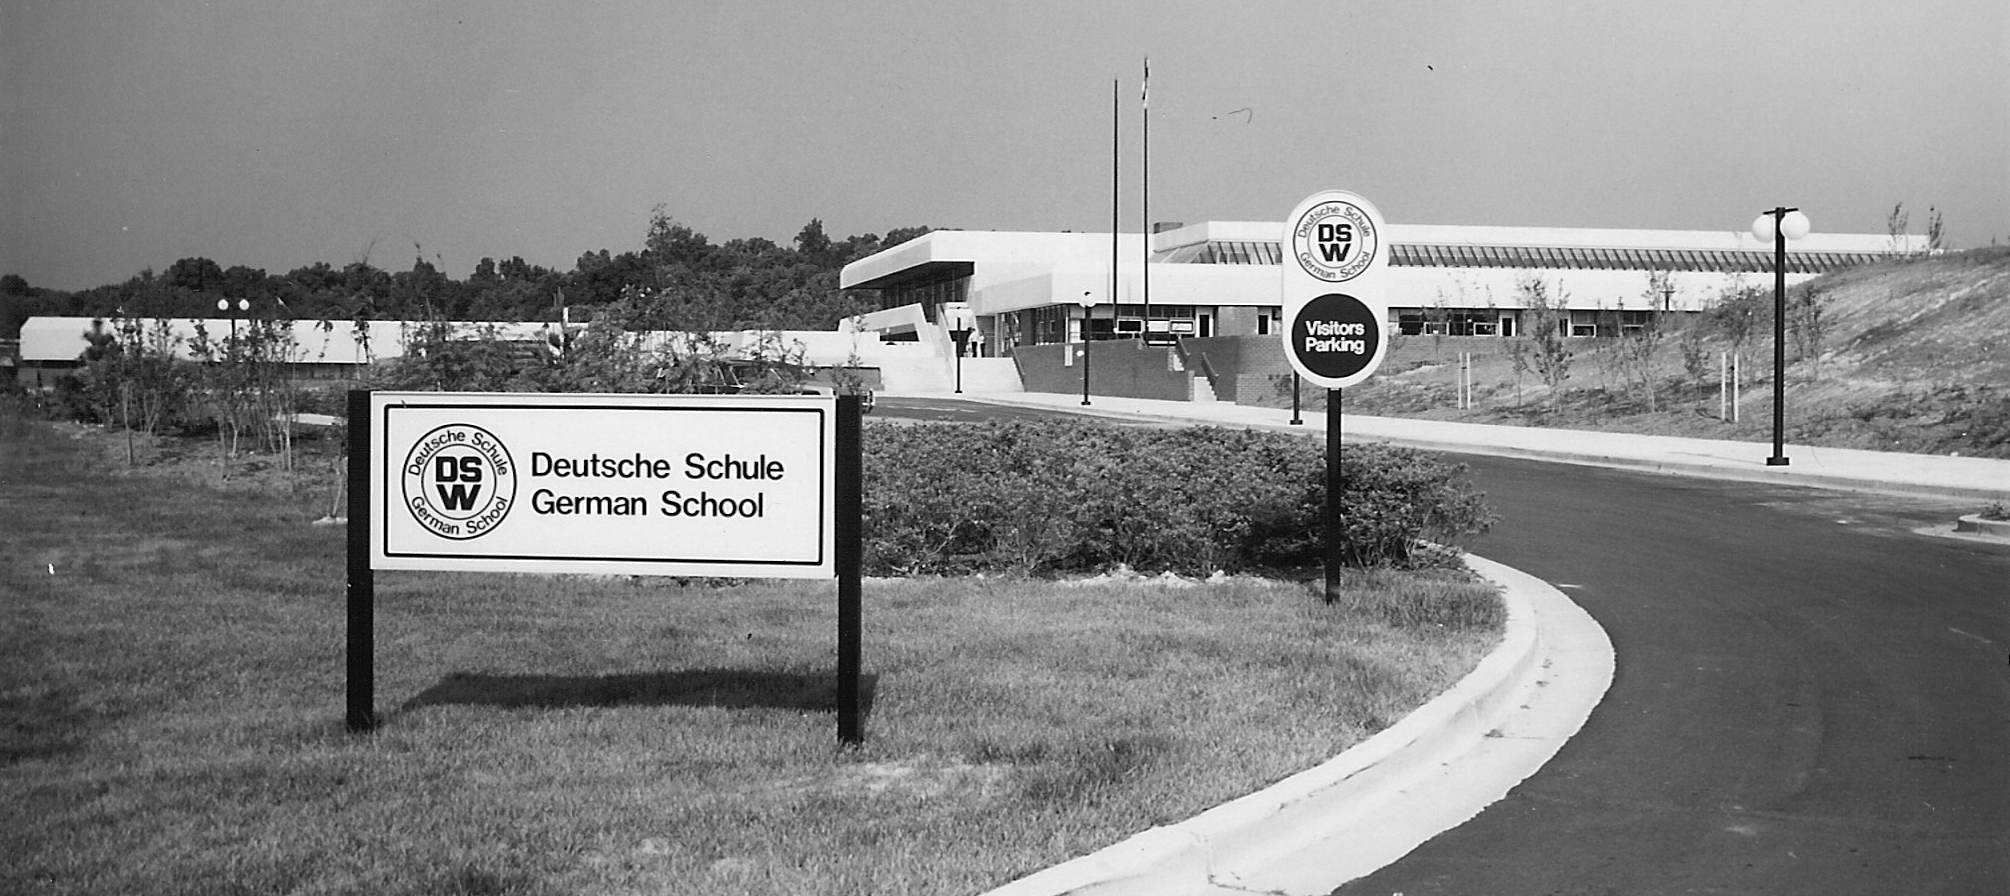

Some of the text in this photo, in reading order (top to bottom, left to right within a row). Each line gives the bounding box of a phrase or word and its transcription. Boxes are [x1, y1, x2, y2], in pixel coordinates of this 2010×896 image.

[1298, 206, 1370, 238] Deutsche Schule
[1318, 224, 1352, 242] DS
[1300, 251, 1371, 279] German School
[1319, 243, 1351, 262] W
[1305, 321, 1365, 335] Visitors
[1305, 337, 1365, 354] Parking
[408, 430, 507, 476] Deutsche Schule
[532, 452, 784, 480] Deutsche Schule
[436, 456, 482, 482] DS
[436, 484, 482, 510] W
[532, 489, 764, 517] German School
[412, 496, 508, 534] German School
